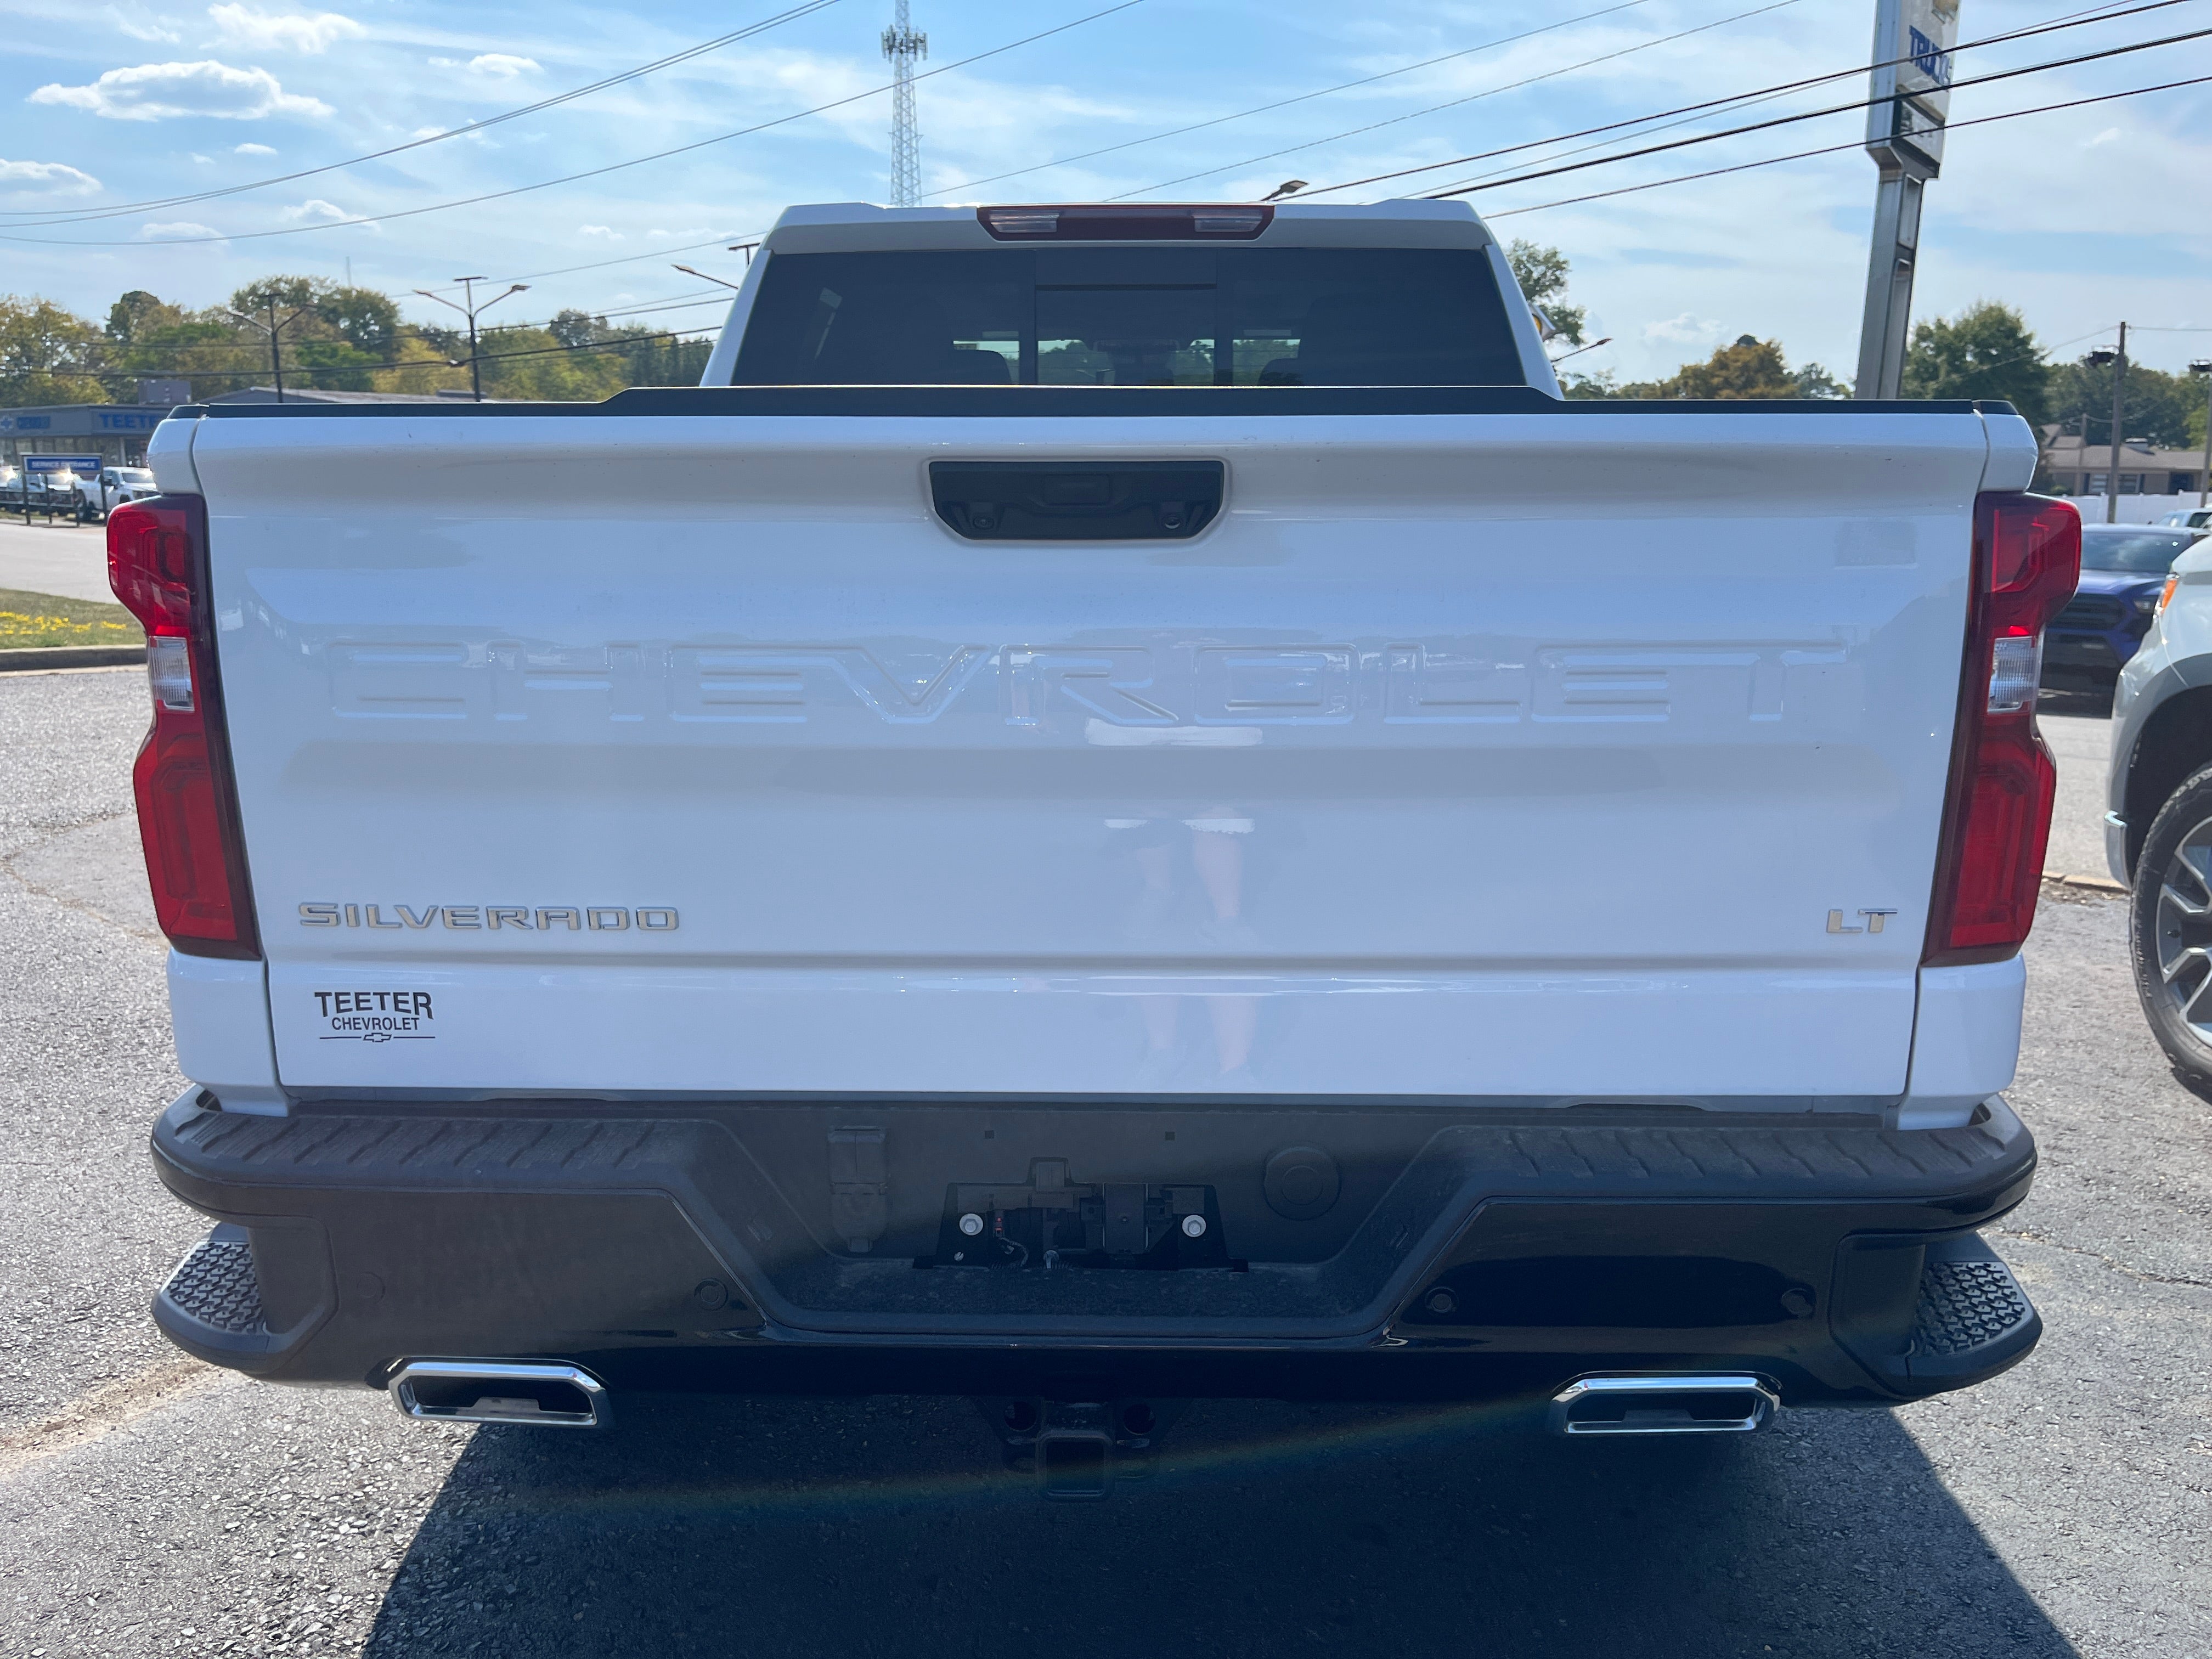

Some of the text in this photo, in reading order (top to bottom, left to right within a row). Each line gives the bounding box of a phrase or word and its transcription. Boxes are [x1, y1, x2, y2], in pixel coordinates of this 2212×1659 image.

[99, 414, 158, 428] TEETE
[329, 640, 1846, 725] CHEVROLET
[298, 902, 679, 930] SILVERADO
[1826, 909, 1898, 933] LT
[314, 992, 434, 1019] TEETER
[331, 1017, 420, 1030] CHEVROLET
